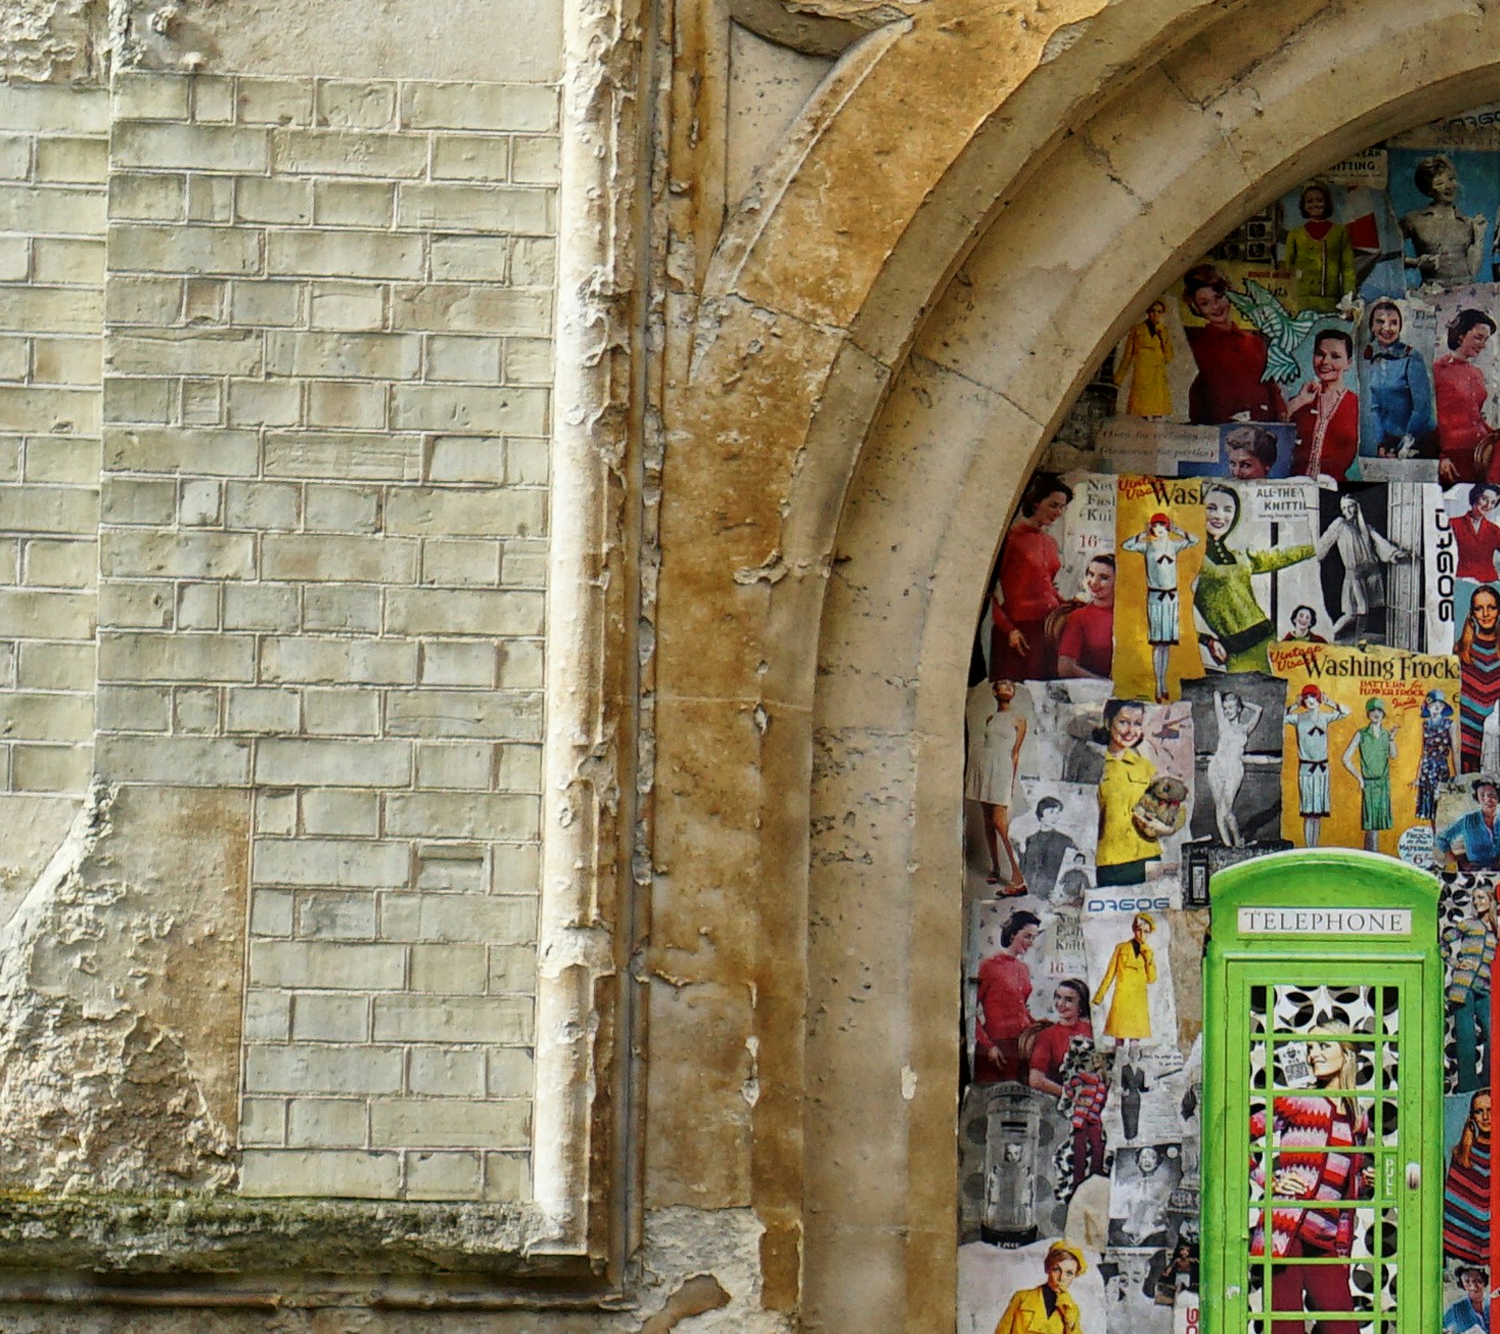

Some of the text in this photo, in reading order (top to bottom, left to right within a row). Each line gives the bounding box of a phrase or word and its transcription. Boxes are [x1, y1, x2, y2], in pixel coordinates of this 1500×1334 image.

[1079, 534, 1099, 548] 16
[1302, 654, 1395, 680] Washing
[1087, 897, 1170, 913] D7606
[1245, 911, 1403, 932] TELEPHONE
[1049, 962, 1065, 974] 16
[1385, 1158, 1394, 1196] PULL
